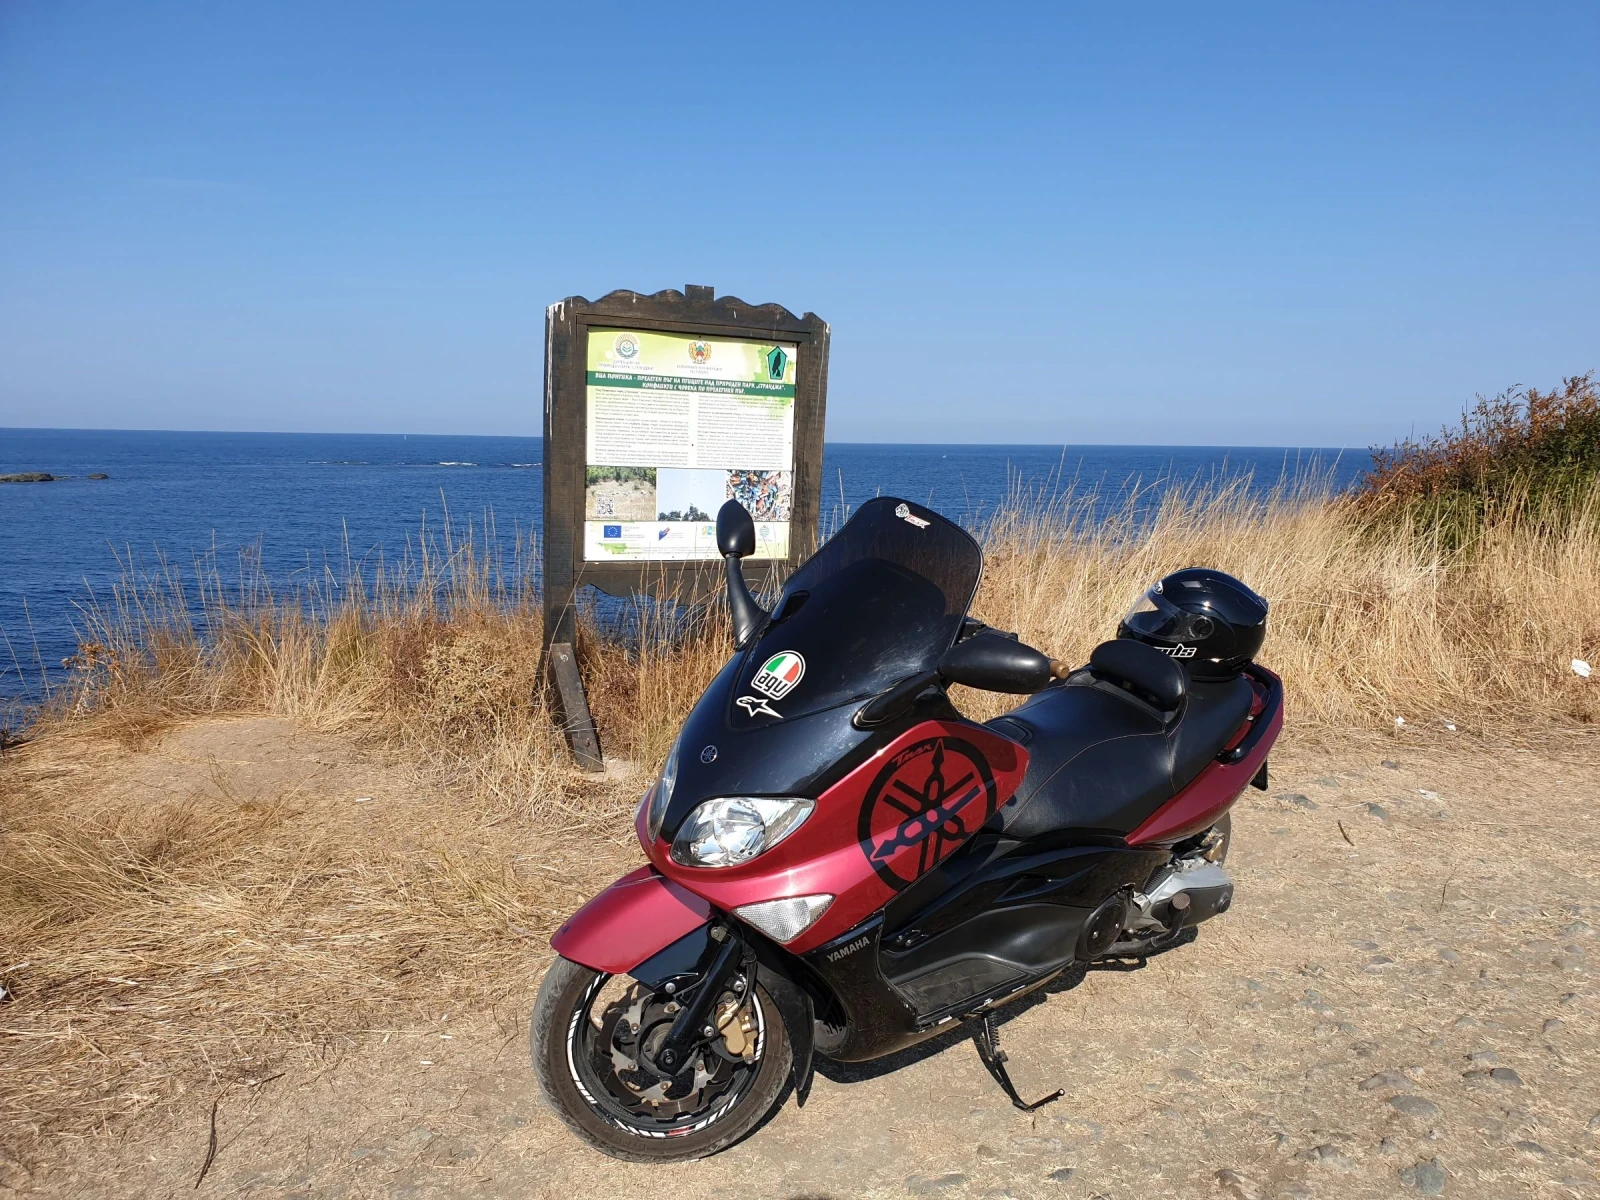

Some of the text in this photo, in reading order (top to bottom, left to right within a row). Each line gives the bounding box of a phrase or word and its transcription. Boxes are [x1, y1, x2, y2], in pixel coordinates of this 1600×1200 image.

[715, 380, 741, 388] ПРИРОДЕН
[758, 672, 788, 692] agv
[826, 936, 871, 963] YAMAHA
